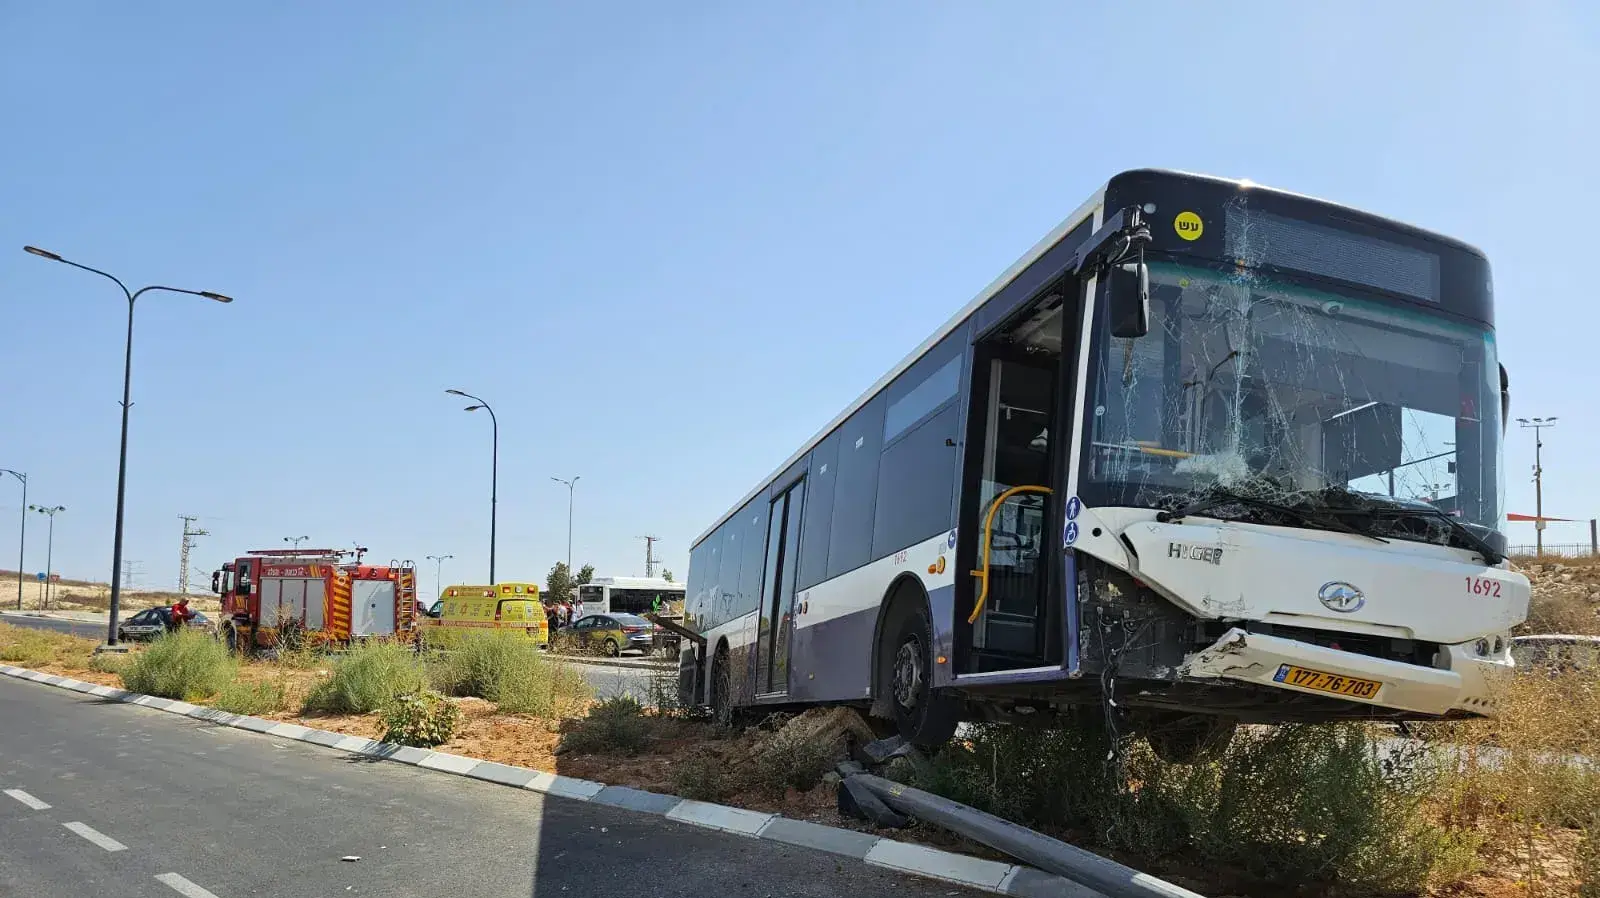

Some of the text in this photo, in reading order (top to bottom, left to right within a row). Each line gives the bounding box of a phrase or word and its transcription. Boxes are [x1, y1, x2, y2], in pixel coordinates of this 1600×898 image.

[1179, 221, 1199, 231] עש
[1168, 542, 1223, 565] HIGER
[1465, 576, 1501, 598] 1692
